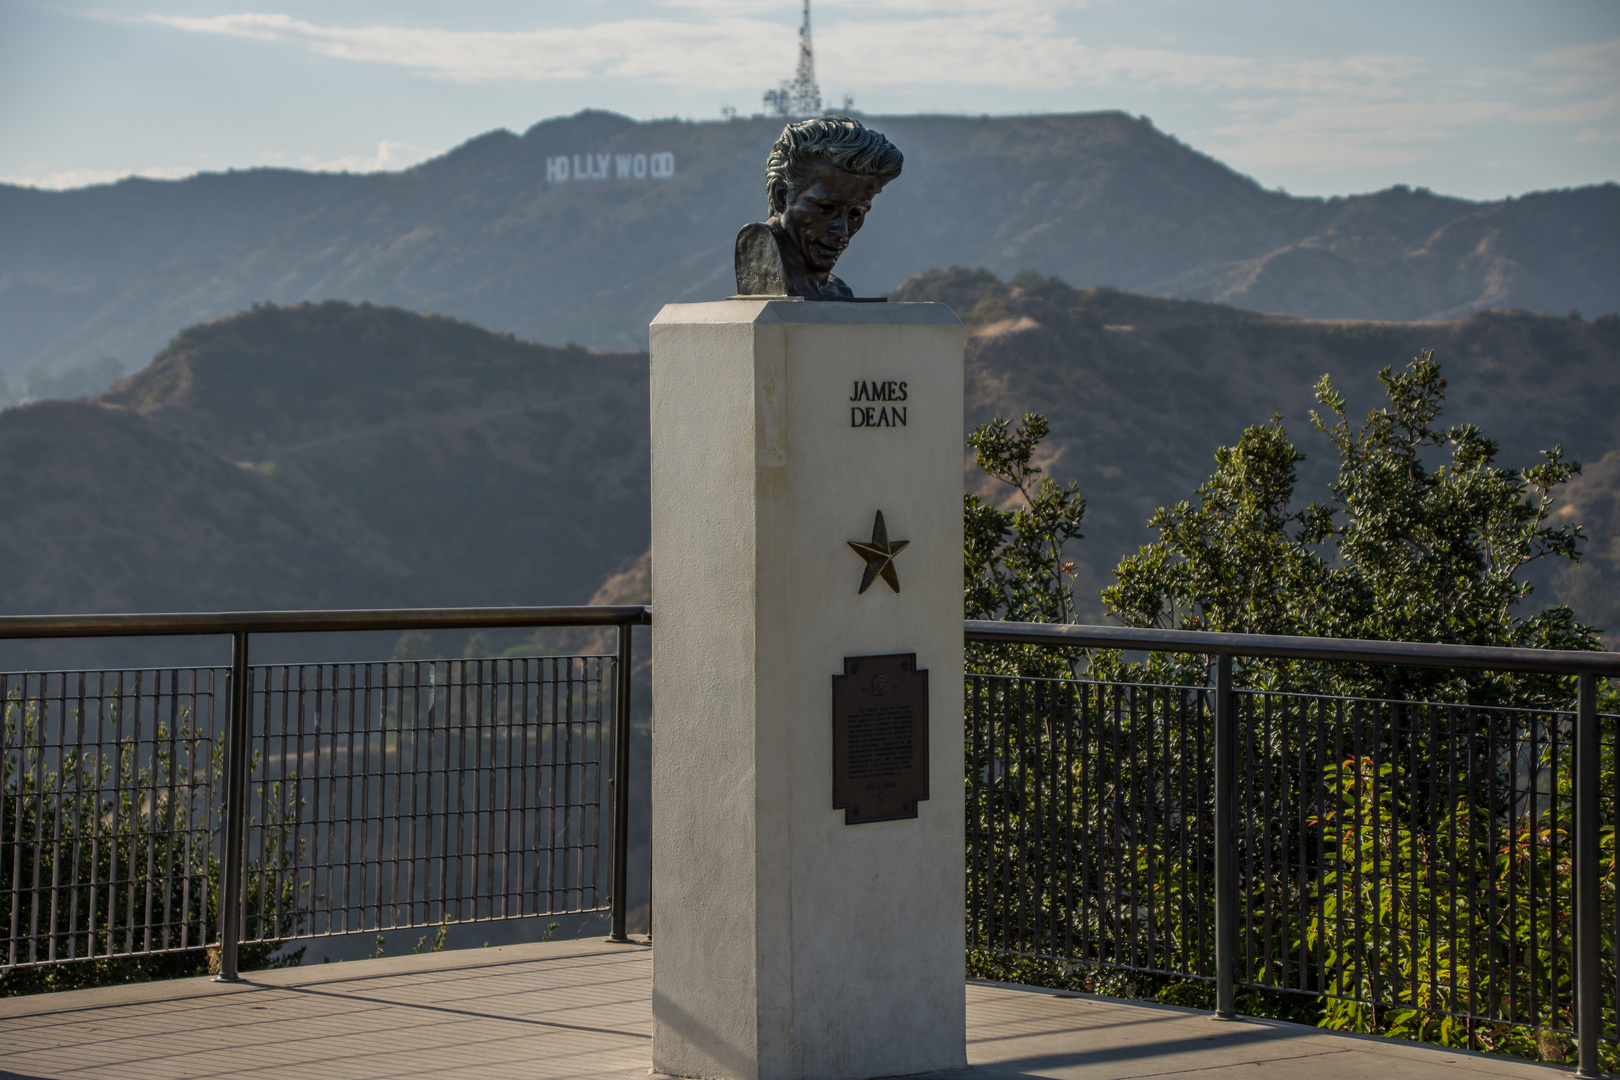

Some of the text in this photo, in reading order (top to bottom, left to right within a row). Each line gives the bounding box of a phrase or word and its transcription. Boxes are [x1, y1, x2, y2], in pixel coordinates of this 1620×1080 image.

[546, 151, 675, 181] HOLLYWOOD
[849, 379, 908, 402] JAMES
[850, 406, 908, 428] DEAN
